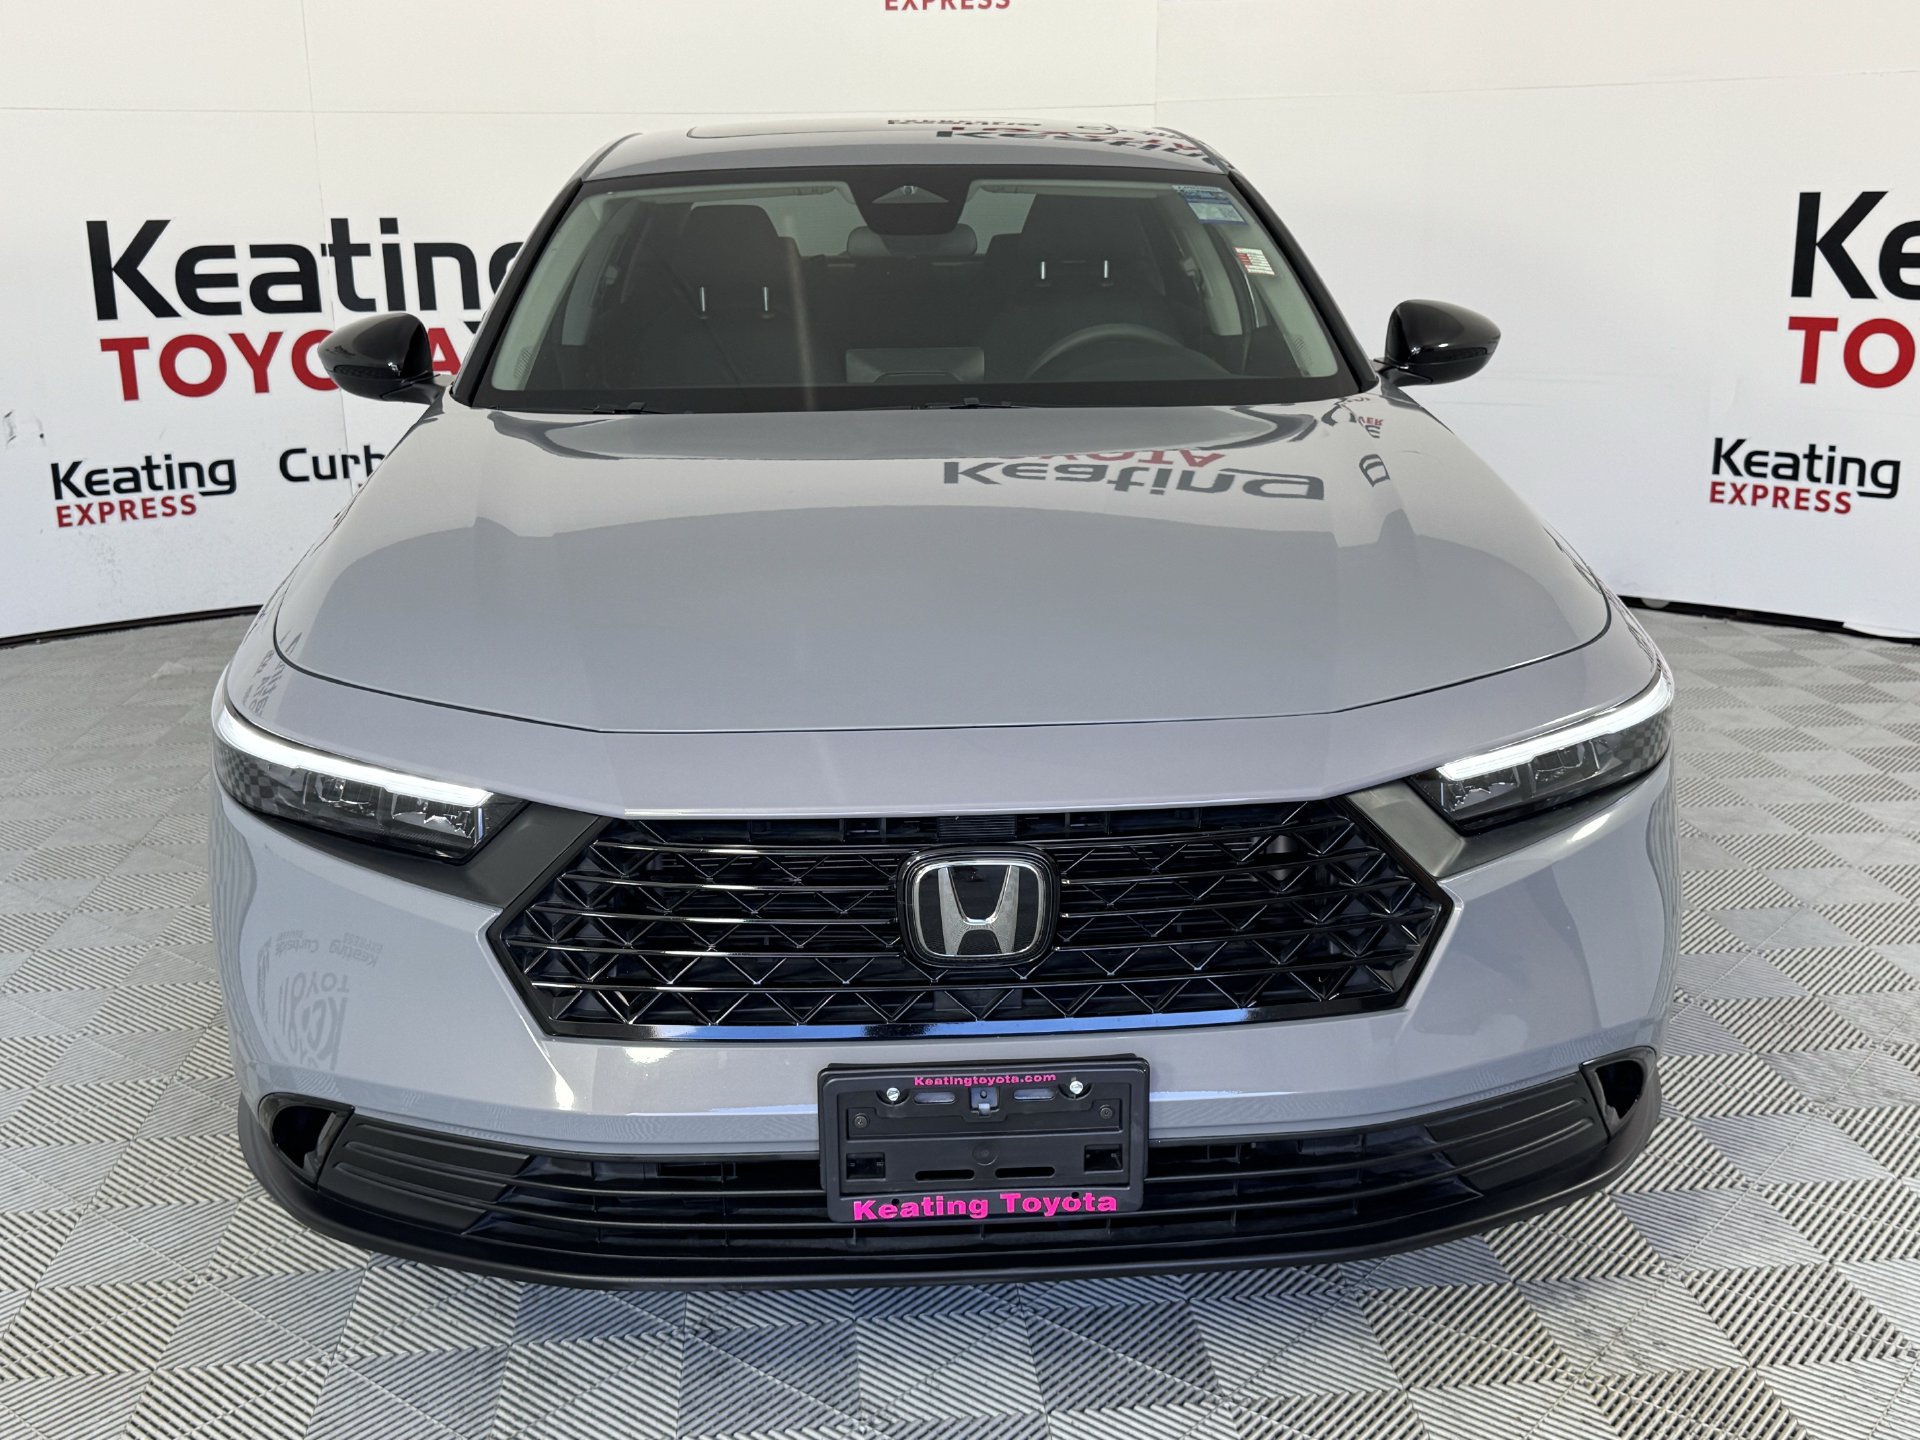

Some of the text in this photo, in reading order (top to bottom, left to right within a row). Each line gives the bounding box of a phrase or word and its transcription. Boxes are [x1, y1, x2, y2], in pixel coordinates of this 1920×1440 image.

[50, 453, 237, 501] Keating
[1711, 437, 1902, 500] Keating
[56, 493, 198, 528] EXPRESS
[1708, 481, 1853, 515] EXPRESS
[913, 1072, 1057, 1087] Keatingtoyota.com
[853, 1191, 1118, 1221] Keating Toyota
